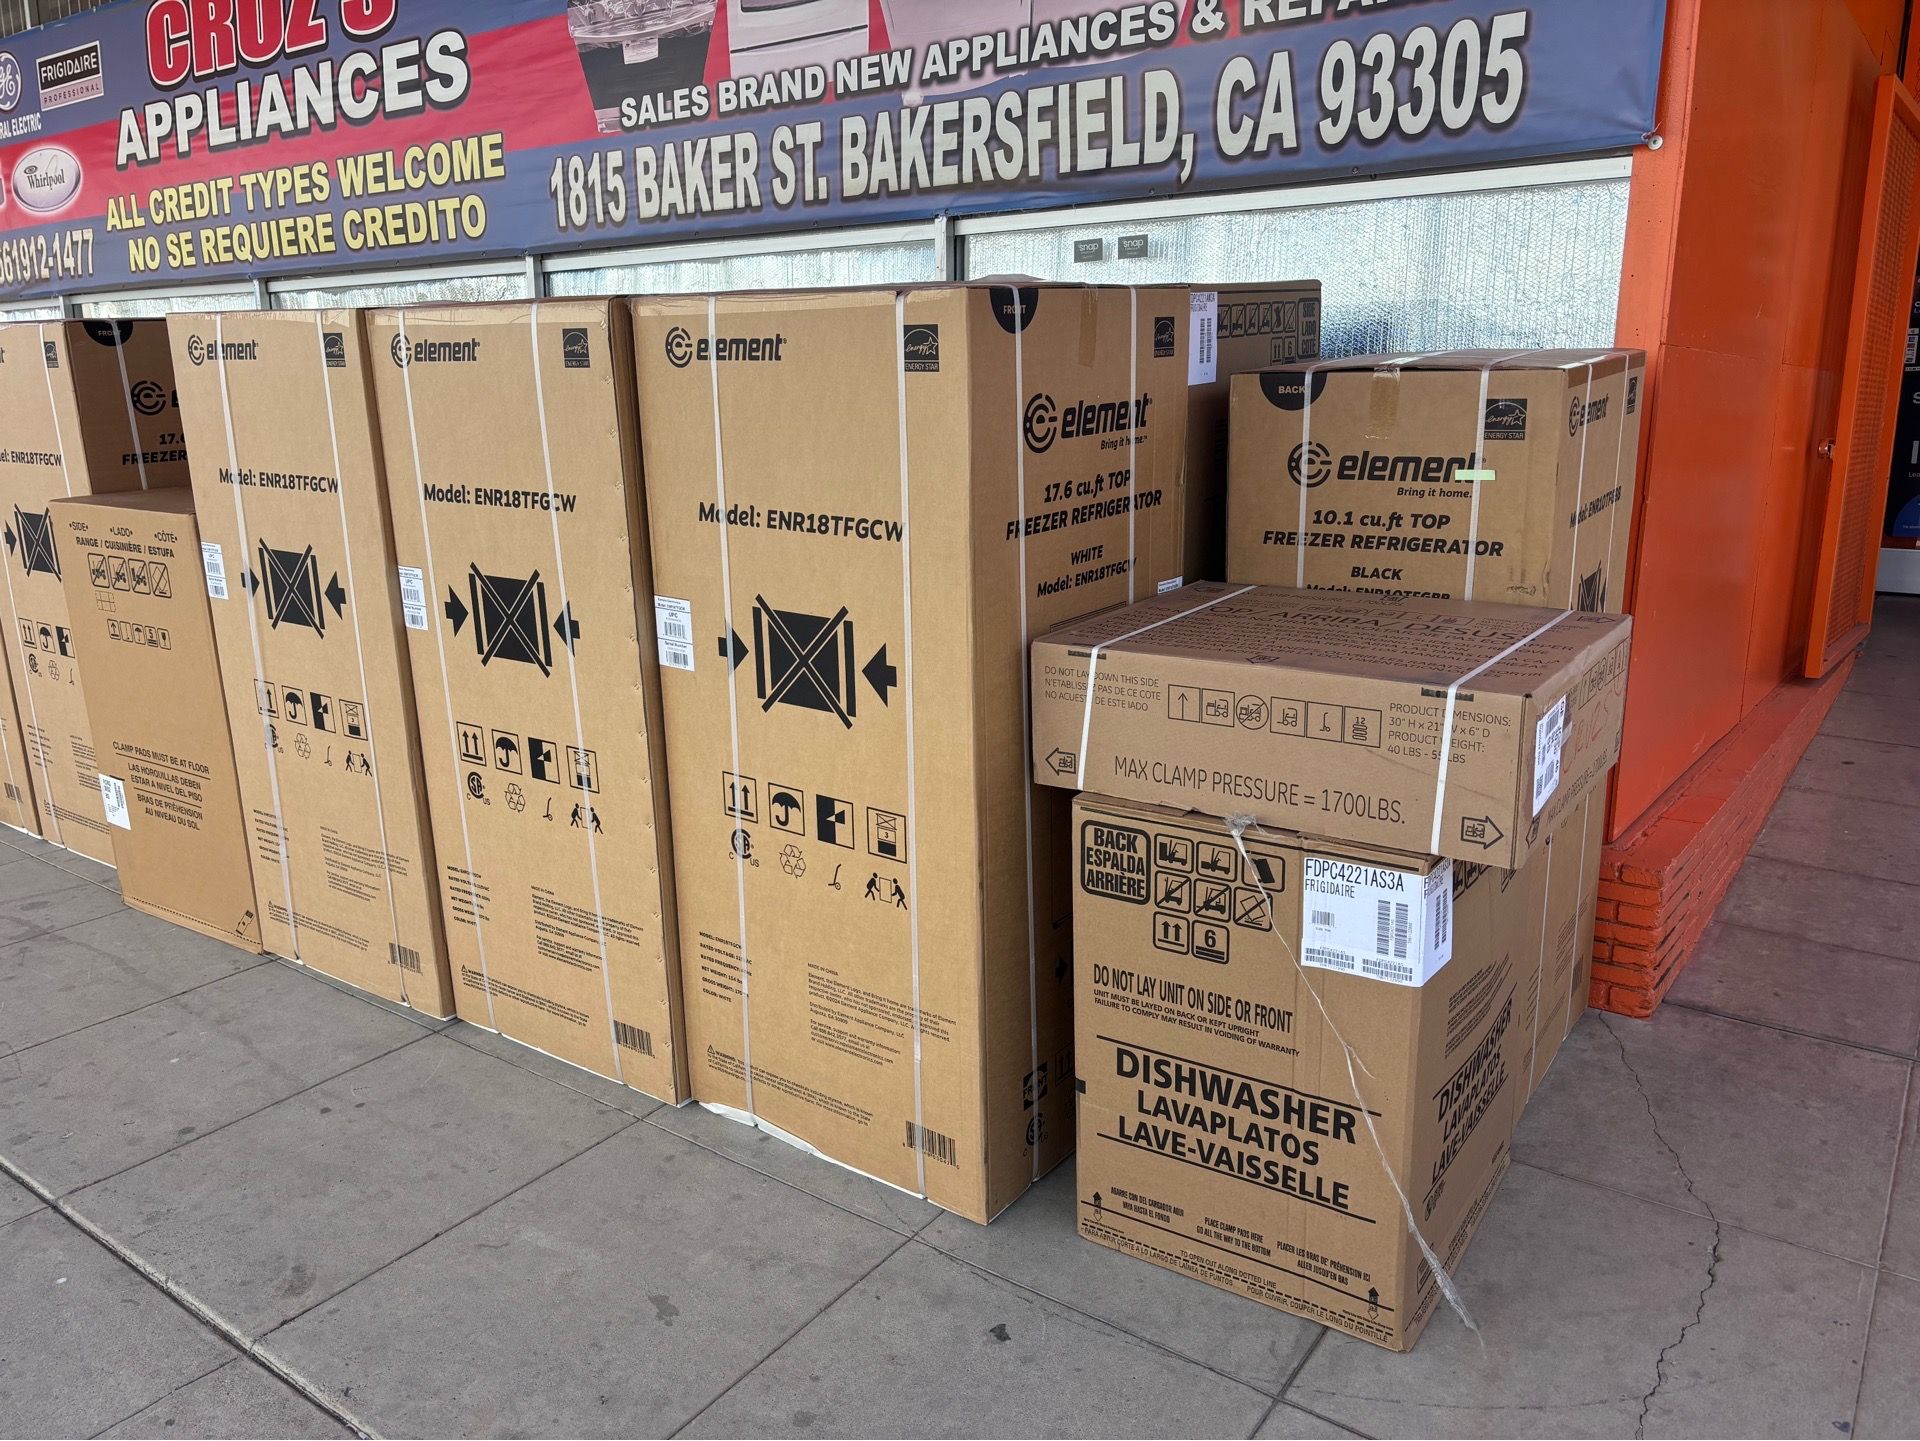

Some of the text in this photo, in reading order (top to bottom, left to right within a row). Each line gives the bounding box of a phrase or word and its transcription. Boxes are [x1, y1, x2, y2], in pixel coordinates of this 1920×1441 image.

[41, 52, 98, 83] FRIGIDAIRE
[621, 85, 708, 129] SALES
[719, 69, 825, 112] BRAND
[836, 49, 913, 93] NEW
[922, 1, 1177, 80] APPLIANCES
[1192, 0, 1226, 34] &
[44, 83, 100, 104] PROFESSIONAL
[116, 31, 470, 167] APPLIANCES
[549, 11, 1527, 228] 1815 BAKER ST. BAKERSFIELD, CA 93305
[27, 169, 65, 190] Whirlpool
[106, 133, 505, 233] ALL CREDIT TYPES WELCOME
[128, 194, 487, 272] NO SE REQUIERE CREDITO
[1003, 304, 1026, 315] FROT
[414, 338, 477, 362] element
[697, 334, 782, 361] eement
[1278, 385, 1306, 395] BACK
[260, 472, 339, 493] ENR18TFGCW
[423, 483, 470, 504] Model:
[1044, 469, 1131, 503] 17.6 cu.ft TOP
[1397, 487, 1473, 499] Bring it home.
[767, 510, 903, 542] ENR18TFGCW
[1312, 510, 1450, 532] 10.1 cu.ft TOP
[76, 537, 99, 548] RANGE
[148, 546, 175, 558] ESTUFA
[1071, 545, 1103, 565] WHITE
[1263, 530, 1504, 557] FREEZER REFRIGERATOR
[1037, 575, 1072, 597] Model:
[1351, 566, 1404, 581] BLACK
[1045, 665, 1055, 675] DO
[1058, 667, 1074, 677] NOT
[1120, 675, 1139, 685] THIS
[1141, 677, 1159, 687] SIDE
[1098, 686, 1112, 694] PAS
[1115, 687, 1125, 696] DE
[1127, 688, 1137, 697] CE
[1140, 690, 1160, 700] COTE
[1355, 717, 1366, 725] 12
[1390, 703, 1511, 727] PRODUCT MENSIONS:
[1408, 719, 1415, 728] H
[1483, 728, 1490, 738] D
[1388, 730, 1485, 753] PRODUCT EIGHT:
[113, 741, 210, 774] CLAMP PADS MUST BE AT FLOOR
[128, 763, 140, 771] LAS
[180, 777, 201, 791] DEBEN
[131, 775, 150, 787] ESTAR
[156, 782, 174, 794] NIVEL
[175, 786, 187, 797] DEL
[188, 791, 203, 802] PISO
[1115, 756, 1148, 780] MAX
[1152, 762, 1207, 792] CLAMP
[1212, 771, 1300, 806] PRESSURE
[1321, 788, 1406, 825] 1700LBS.
[137, 793, 154, 805] BRAS
[155, 799, 164, 808] DE
[154, 809, 176, 822] NIVEAU
[187, 820, 200, 831] SOL
[1094, 827, 1138, 854] BACK
[1086, 847, 1145, 876] ESPALDA
[1086, 872, 1145, 898] ARRIÈRE
[1304, 879, 1355, 899] FRIGIDAIRE
[1305, 859, 1404, 892] FDPC4221AS3A
[1204, 930, 1216, 948] 6
[1094, 963, 1293, 1033] DO NOT LAY UNIT ON SIDE OR FRONT
[1094, 989, 1259, 1037] UNIT MUST BE LAYED ON BACK OR KEPT UPRIGHT
[1438, 998, 1512, 1123] DISHWASHER
[1116, 1047, 1356, 1144] DISHWASHER
[1443, 1045, 1502, 1144] LAVAPLATOS
[1137, 1090, 1319, 1166] LAVAPLATOS
[1432, 1060, 1505, 1186] LAVE-VAISSELLE
[1118, 1115, 1349, 1210] LAVE-VAISSELLE
[1204, 1217, 1264, 1243] PLACE CLAMP PADS HERE
[1180, 1250, 1277, 1289] TO OPEN CUT ALONG DOTTED LINE
